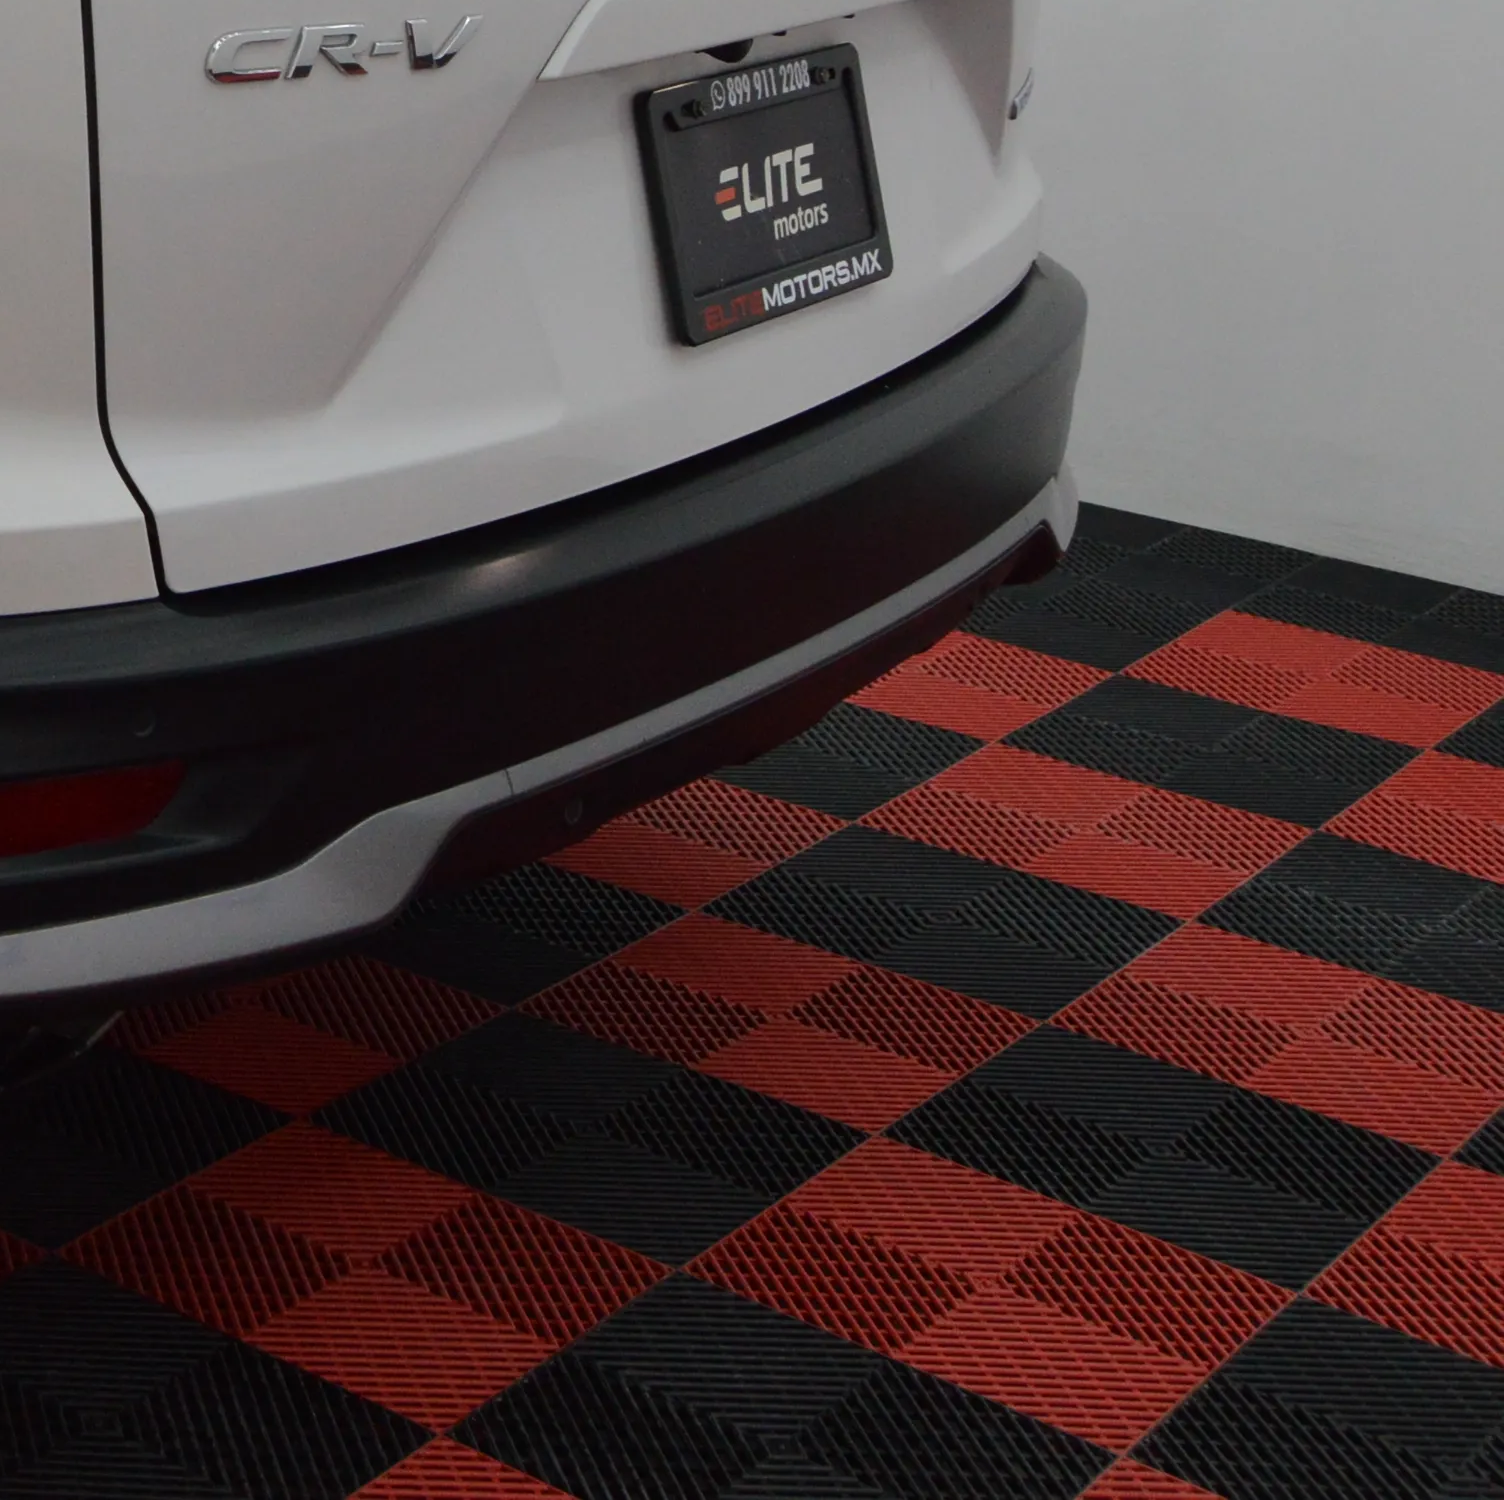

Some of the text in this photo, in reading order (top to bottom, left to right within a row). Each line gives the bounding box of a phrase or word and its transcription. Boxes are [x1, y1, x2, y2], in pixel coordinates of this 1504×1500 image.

[204, 13, 484, 83] CR-V
[726, 59, 811, 108] 899 911 2208
[715, 143, 823, 221] ELITE
[773, 202, 829, 240] motors
